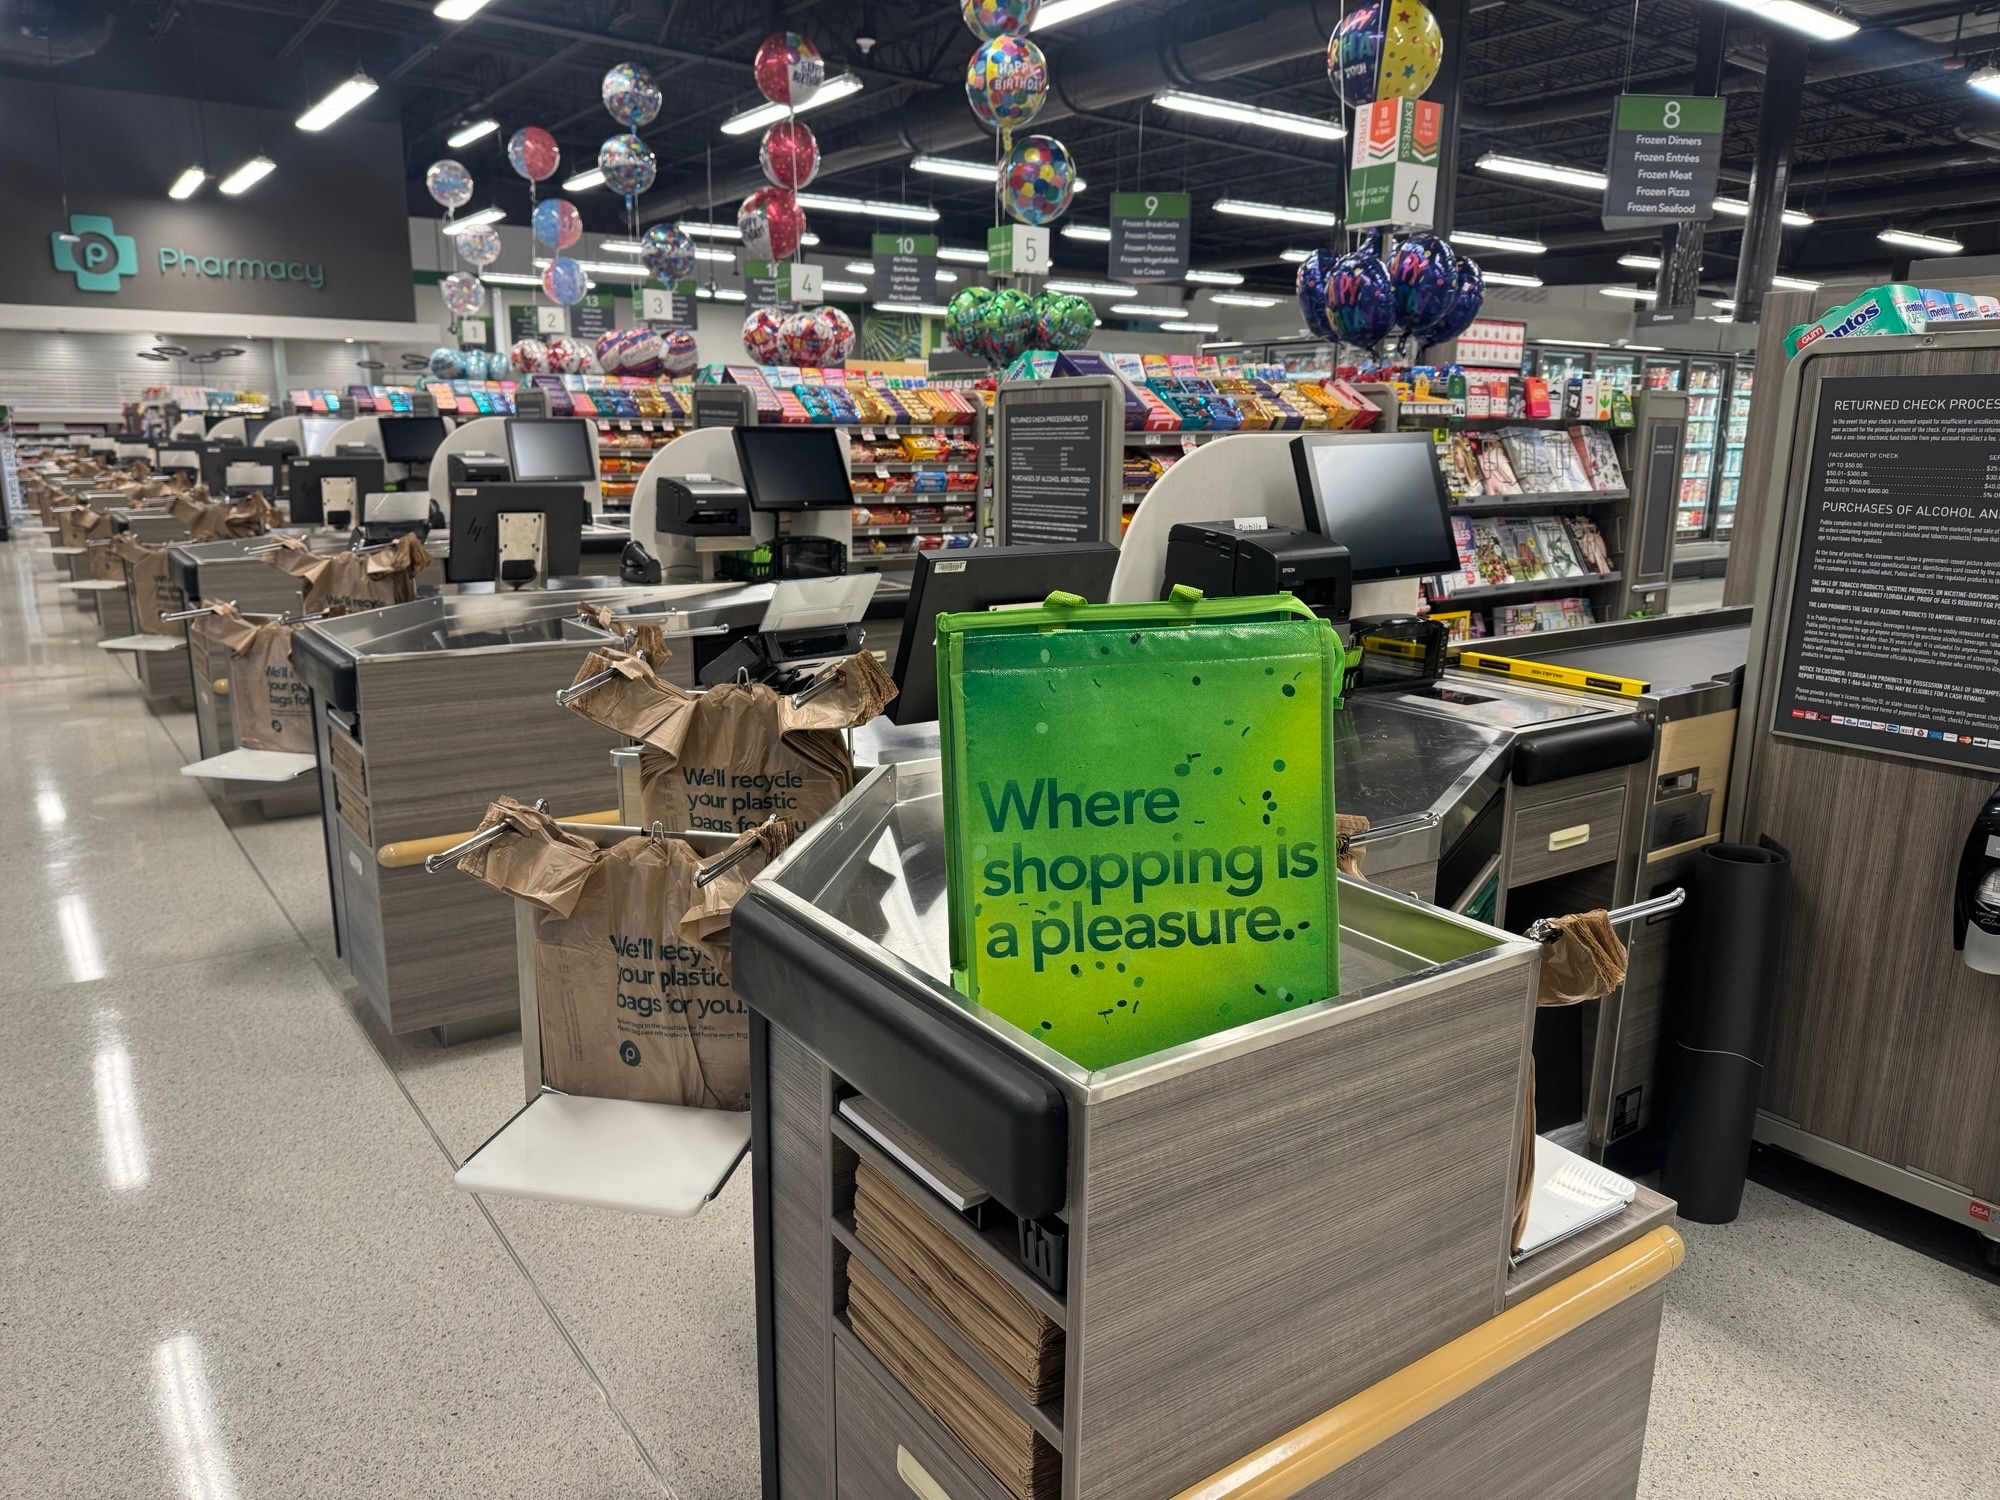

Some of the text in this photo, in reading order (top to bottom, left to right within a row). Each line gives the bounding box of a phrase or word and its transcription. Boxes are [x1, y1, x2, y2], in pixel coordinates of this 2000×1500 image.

[998, 61, 1036, 75] HAPPY
[994, 76, 1044, 90] BIRTHDAY
[1662, 100, 1680, 129] 8
[1356, 108, 1369, 164] EXPRESS
[1402, 101, 1414, 158] EXPRESS
[1636, 134, 1702, 146] Frozen Dinners
[1634, 152, 1700, 163] Frozen Entrées
[1638, 169, 1693, 180] Frozen Meat
[1367, 187, 1378, 196] FOR
[1379, 185, 1390, 194] THE
[1408, 180, 1420, 213] 6
[1636, 186, 1690, 197] Frozen Pizza
[1144, 196, 1158, 217] 9
[1370, 196, 1385, 205] PART
[1627, 202, 1696, 213] Frozen Seafood
[1145, 220, 1179, 228] Breakfasts
[1147, 232, 1176, 240] Desserts
[896, 237, 915, 254] 10
[1025, 238, 1036, 262] 5
[1147, 244, 1176, 252] Potatoes
[1143, 256, 1179, 265] Vegetables
[159, 248, 324, 289] Pharmacy
[803, 274, 812, 294] 4
[586, 295, 599, 307] 13
[654, 298, 663, 314] 3
[1929, 307, 1953, 317] mentos
[1958, 310, 1979, 320] mentos
[547, 313, 556, 328] 2
[471, 326, 478, 339] 1
[1800, 327, 1823, 344] GUM
[1834, 400, 1899, 410] RETURNED
[1902, 400, 1946, 410] CHECK
[1822, 502, 2000, 519] PURCHASES OF ALCOHOL AN
[1944, 590, 1999, 600] NICOTINE-DISPENSING
[682, 767, 803, 792] We'll recycle
[687, 792, 797, 815] your plastic
[978, 777, 1180, 832] Where
[690, 813, 733, 833] bags
[983, 842, 1319, 906] shopping is
[986, 922, 1019, 959] a
[609, 934, 712, 967] We'll recy
[617, 964, 729, 993] your plastic
[617, 987, 662, 1017] bags
[1971, 1206, 1988, 1216] DSA
